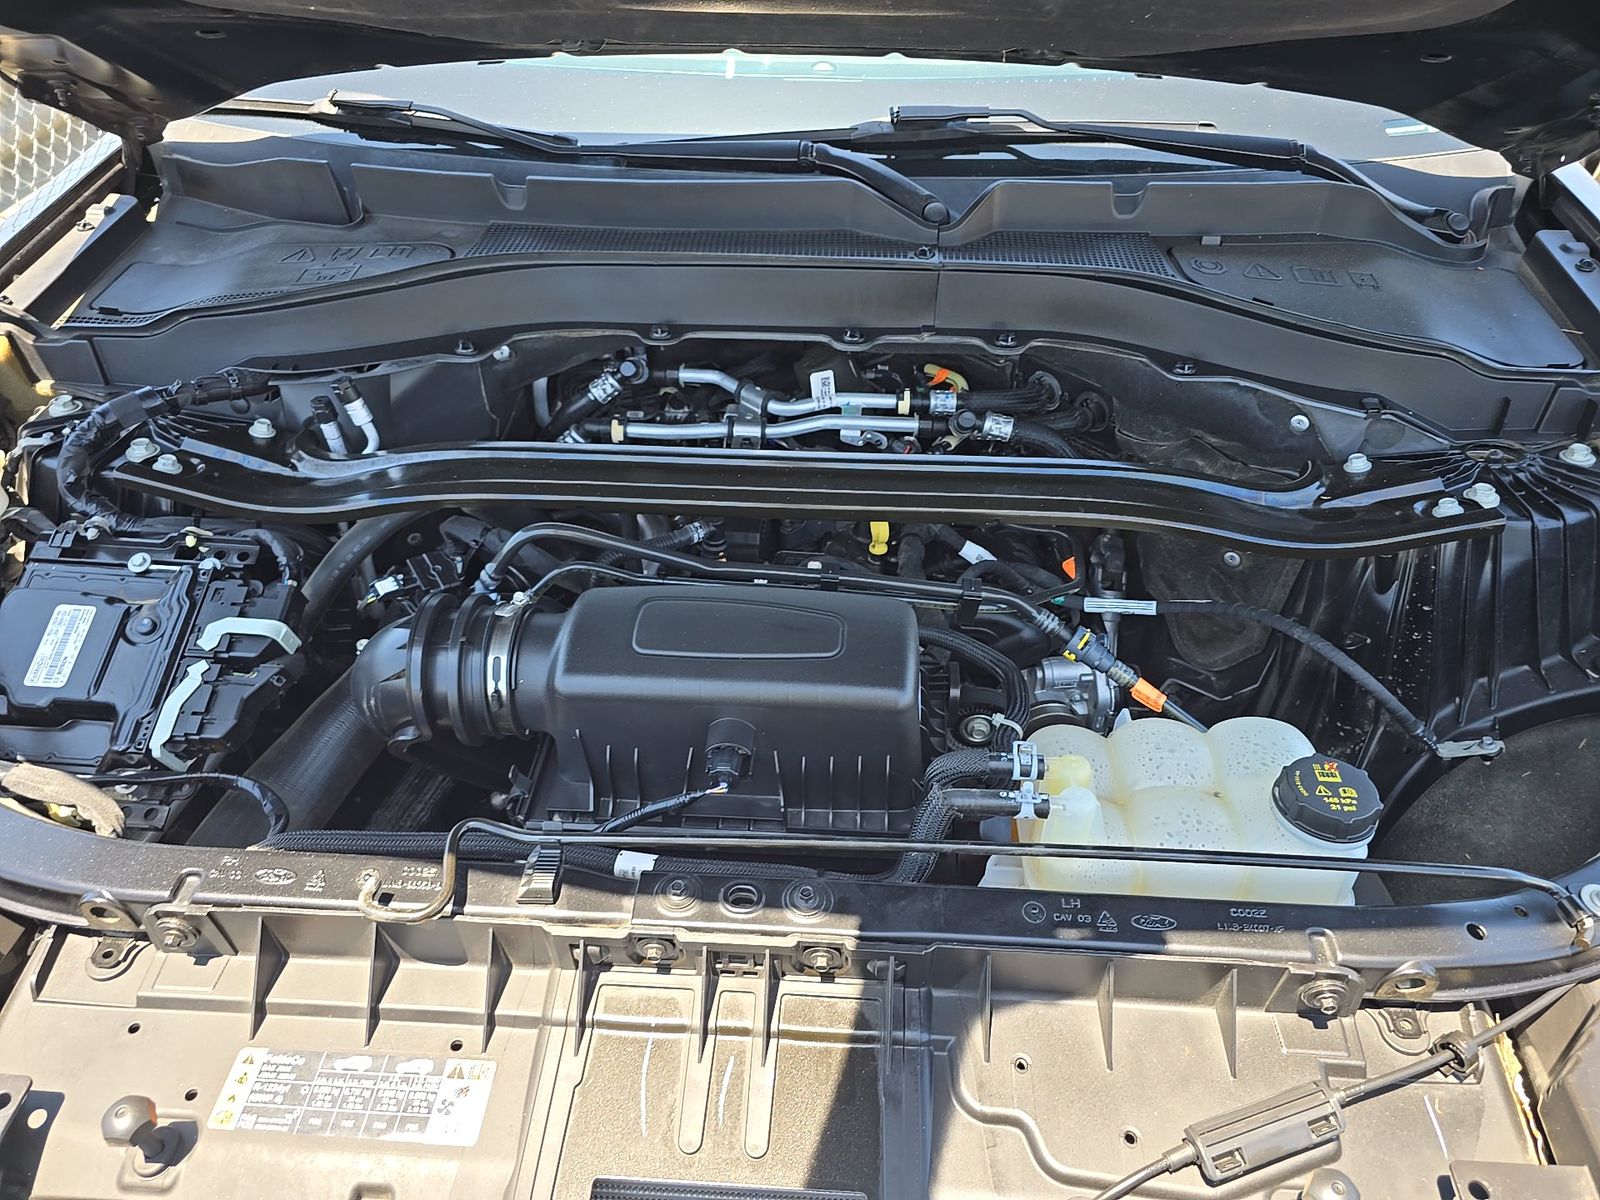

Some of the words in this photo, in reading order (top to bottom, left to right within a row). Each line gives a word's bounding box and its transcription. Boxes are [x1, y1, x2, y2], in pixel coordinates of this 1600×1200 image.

[1061, 898, 1081, 908] LH
[1053, 913, 1072, 922] CAV
[1136, 915, 1173, 929] Ford
